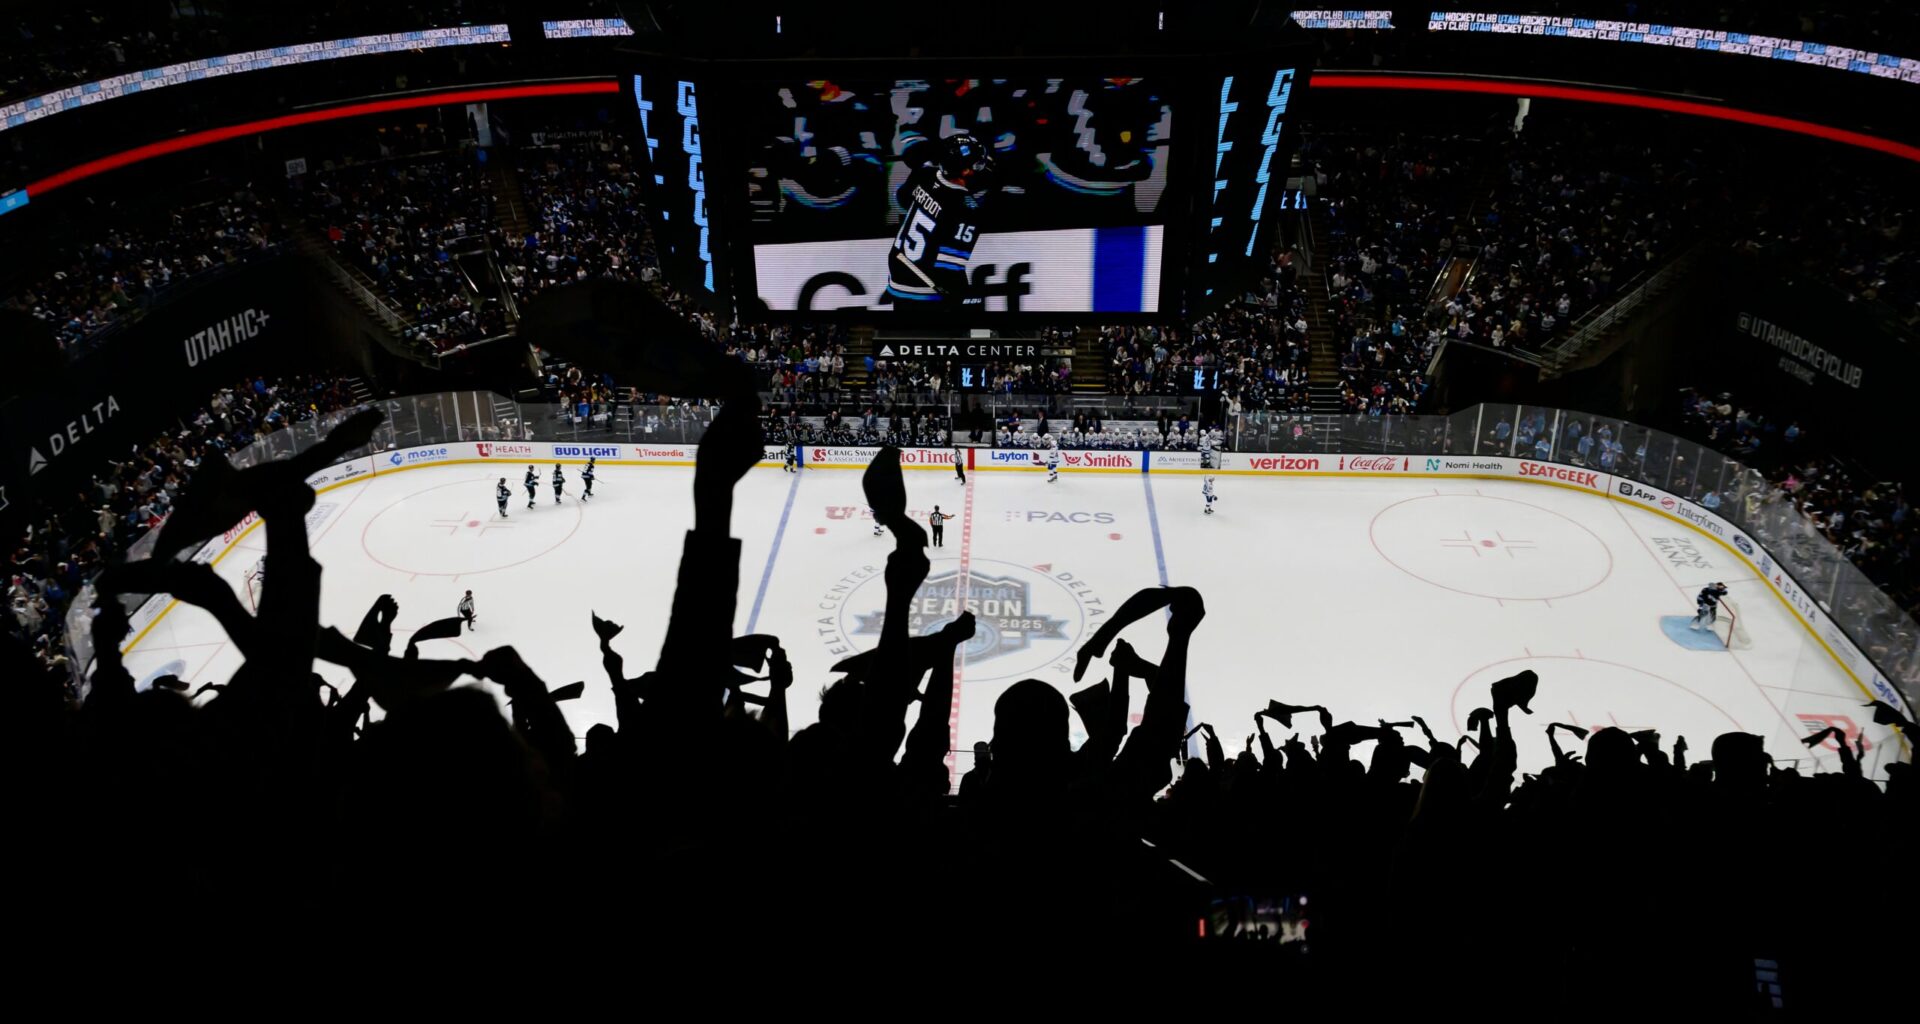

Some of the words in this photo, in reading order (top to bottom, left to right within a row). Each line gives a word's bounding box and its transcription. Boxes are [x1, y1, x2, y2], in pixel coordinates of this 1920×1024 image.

[954, 222, 976, 243] 15
[184, 319, 233, 368] UTAH
[898, 345, 960, 357] DELTA
[966, 345, 1035, 357] CENTER
[49, 395, 121, 457] DELTA
[408, 448, 447, 459] moxie
[495, 446, 532, 454] HEALTH
[555, 447, 581, 456] BUD
[583, 448, 618, 457] LIGHT
[828, 449, 854, 458] CRAIG
[857, 449, 878, 458] SWAP
[992, 451, 1029, 464] Layton
[1083, 452, 1132, 467] Smith's
[1250, 456, 1319, 470] verizon
[1446, 461, 1470, 470] Nomi
[1473, 462, 1503, 471] Health
[1519, 462, 1598, 489] SEATGEEK
[1027, 510, 1115, 525] PACS
[818, 565, 881, 611] CENTER
[1056, 572, 1105, 616] DELTA
[908, 598, 1022, 617] SEASON
[1783, 582, 1816, 623] DELTA
[999, 619, 1043, 630] 2025
